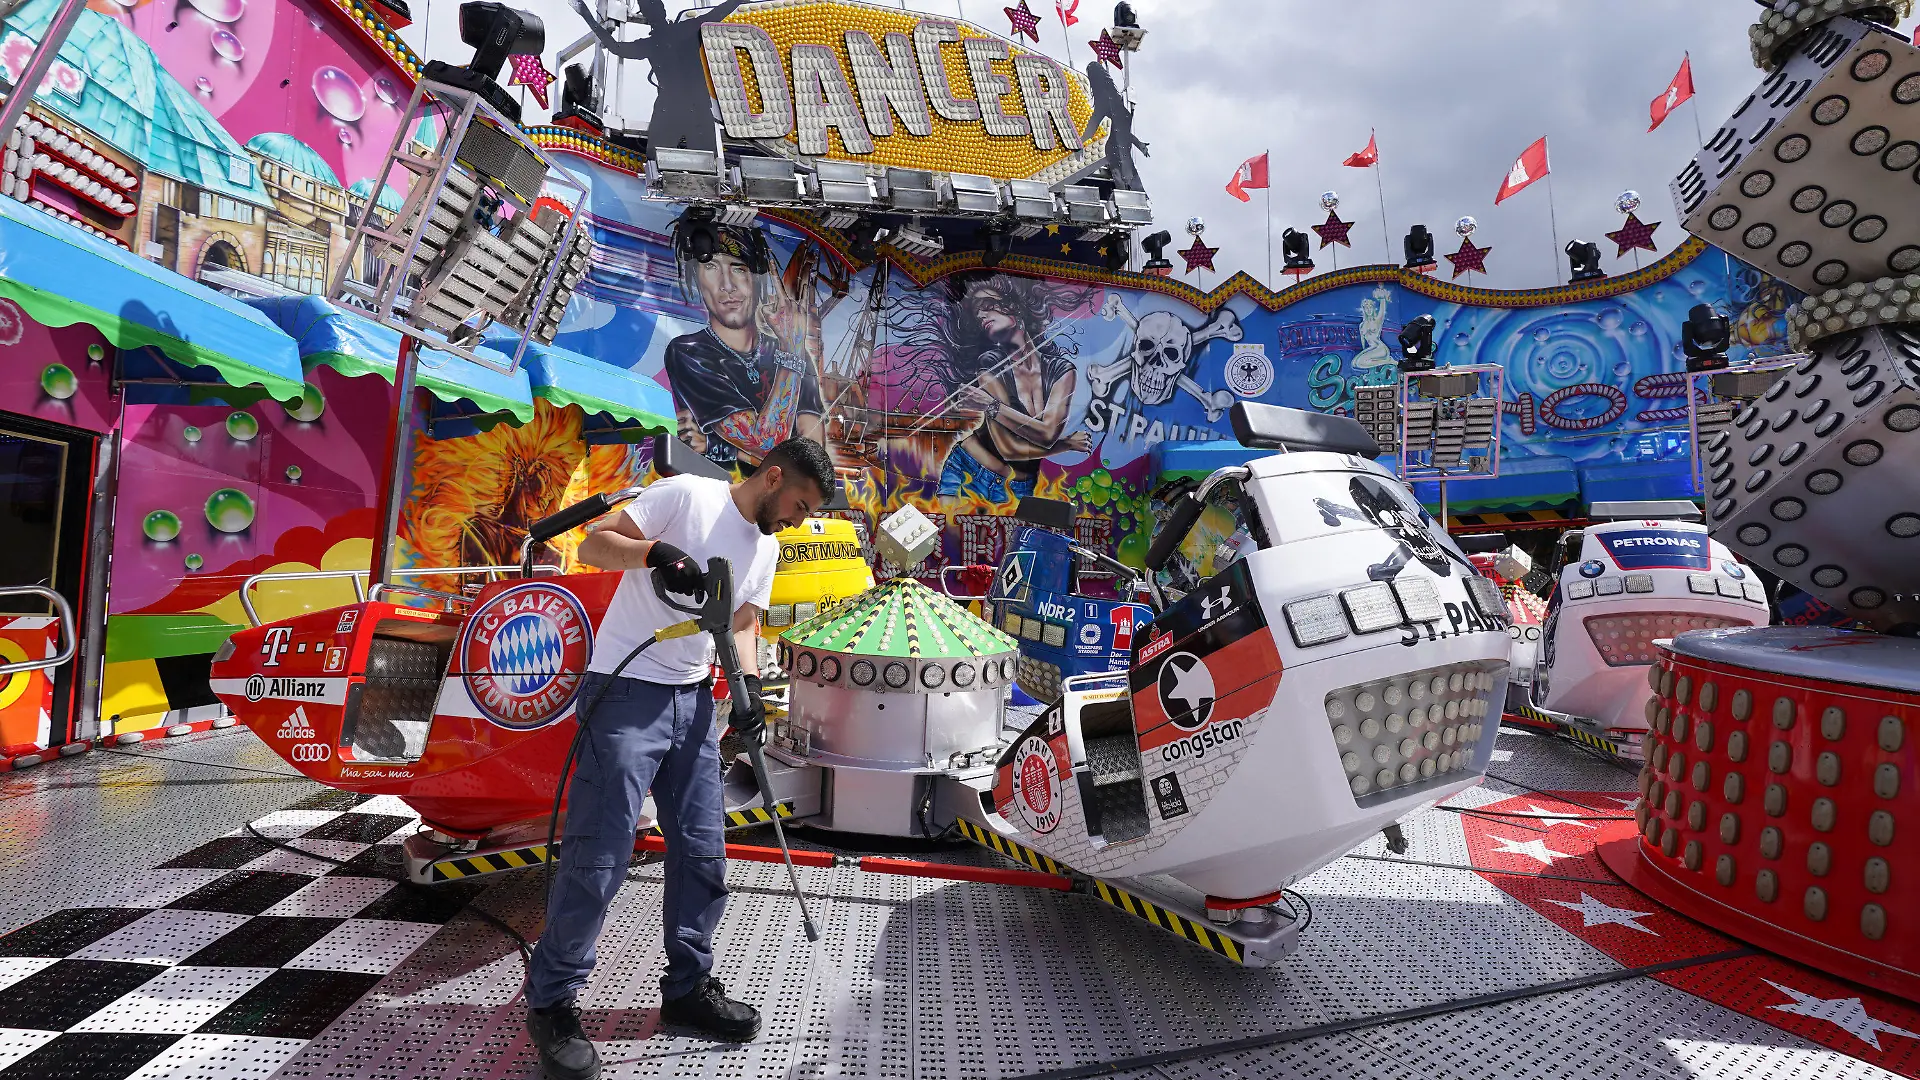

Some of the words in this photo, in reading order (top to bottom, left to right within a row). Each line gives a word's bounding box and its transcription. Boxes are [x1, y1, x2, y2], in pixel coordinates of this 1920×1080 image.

[700, 21, 1083, 155] DANCER
[778, 541, 858, 563] ORTMUND
[1612, 537, 1701, 548] PETRONAS
[475, 613, 499, 645] FC
[503, 593, 583, 646] BAYERN
[1037, 601, 1065, 620] NDR
[1065, 607, 1076, 622] 2
[1197, 619, 1216, 633] UNDER
[1216, 606, 1240, 622] ARMOUR
[263, 626, 293, 667] T
[1141, 636, 1171, 660] ASTRA
[329, 649, 341, 669] 3
[268, 678, 326, 697] Allianz
[276, 727, 316, 739] adidas
[1162, 720, 1243, 762] congstar
[340, 767, 361, 779] Mia
[388, 768, 415, 779] mia
[1013, 771, 1021, 789] FC
[1029, 739, 1056, 774] PAULI
[1035, 811, 1056, 829] 1910
